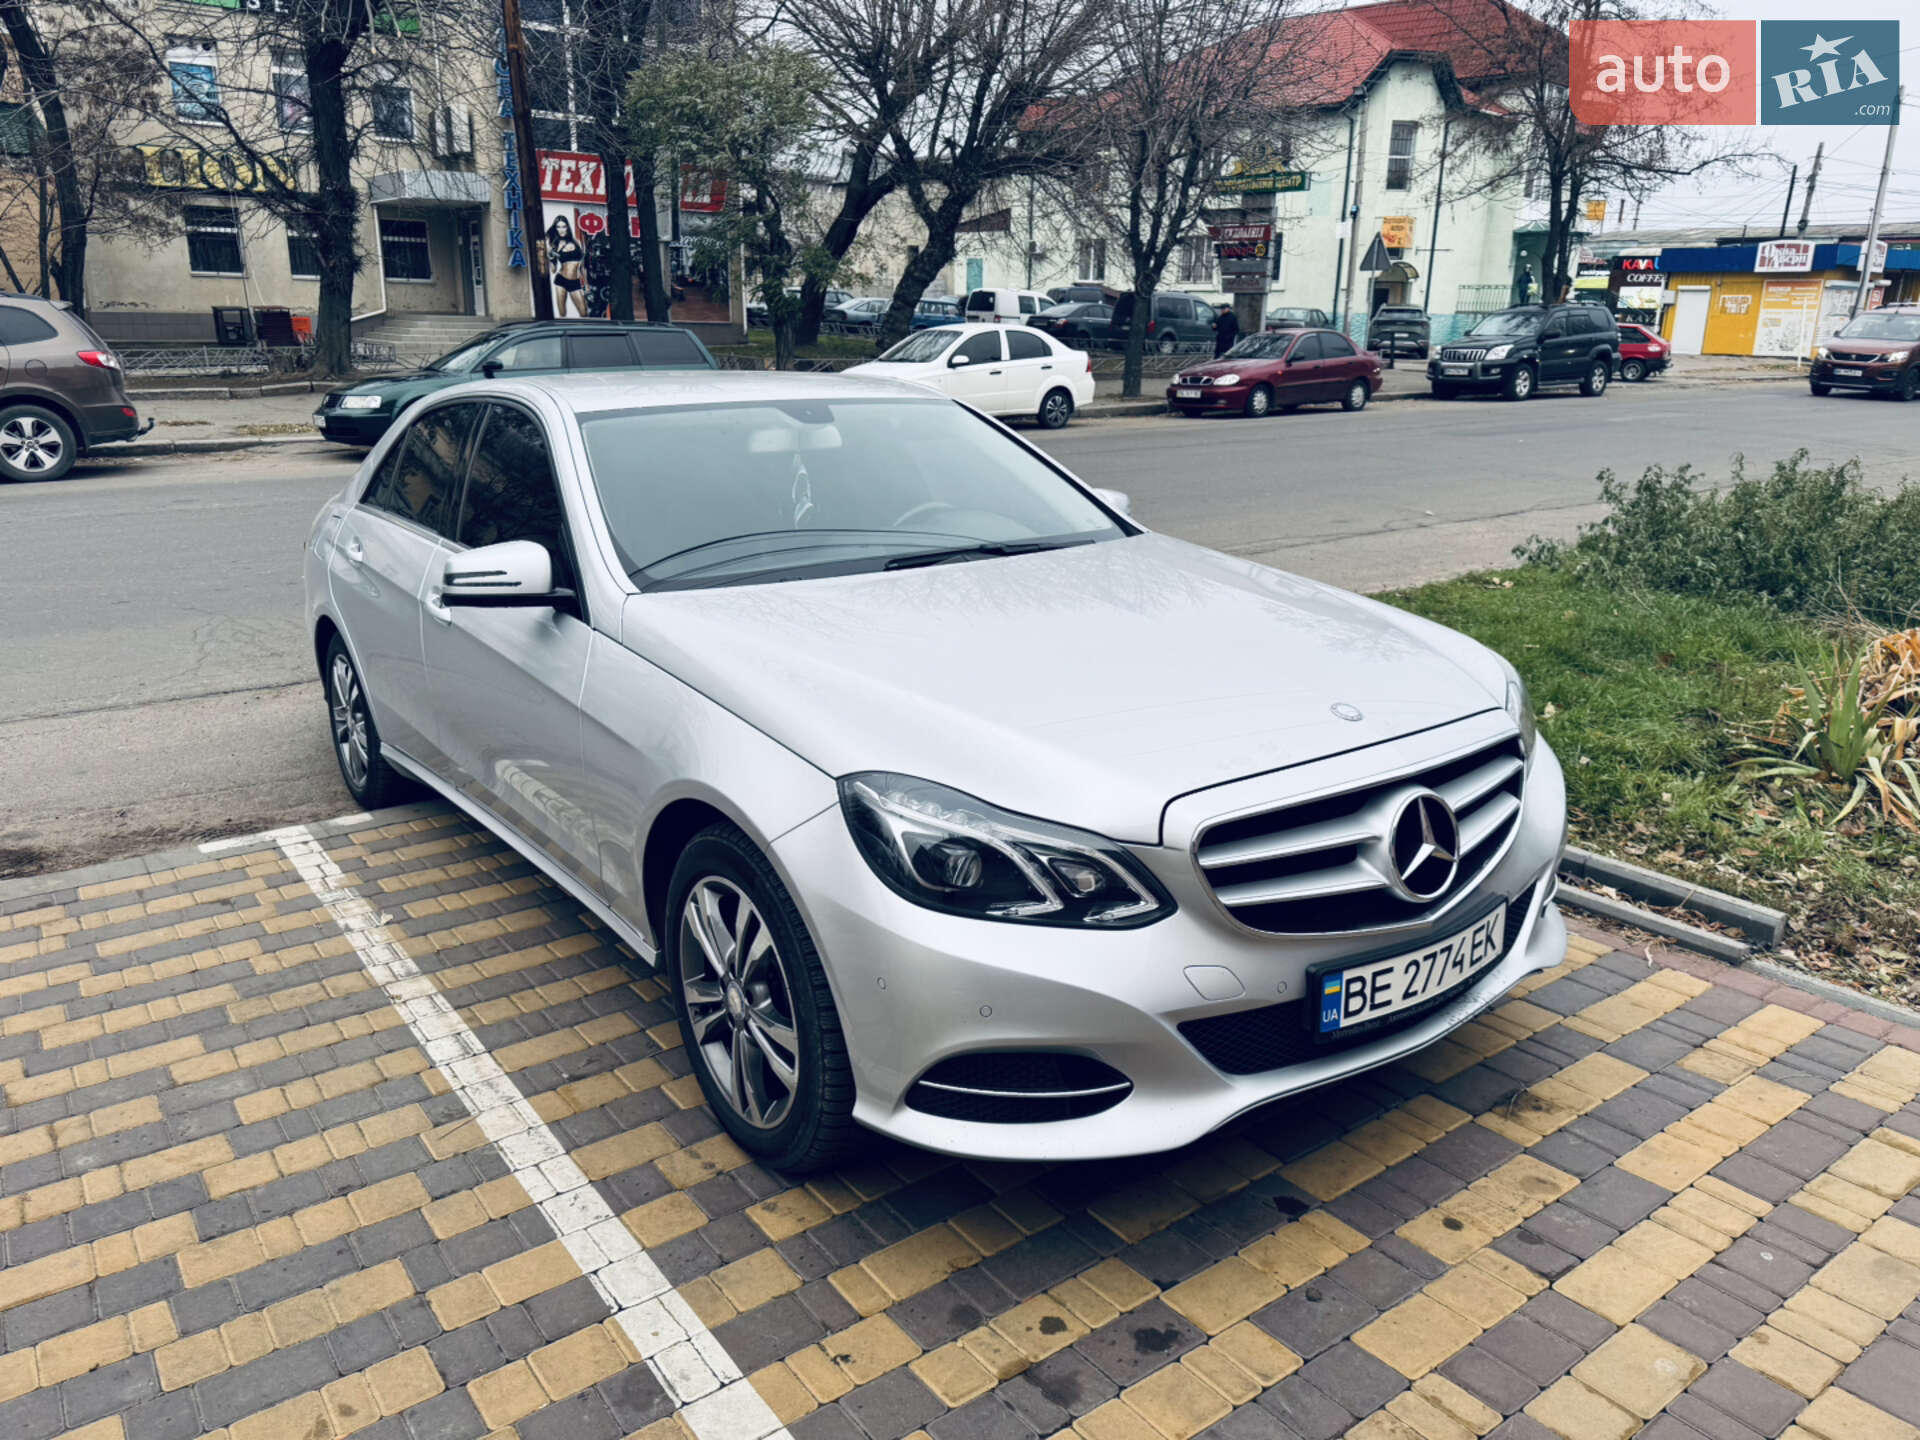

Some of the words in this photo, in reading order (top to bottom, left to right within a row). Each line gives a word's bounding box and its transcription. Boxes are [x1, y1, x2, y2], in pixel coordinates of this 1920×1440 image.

[502, 130, 527, 268] ТЕХНІКА
[1322, 1008, 1339, 1023] UA
[1343, 966, 1394, 1020] BE
[1402, 936, 1466, 1001] 2774
[1470, 913, 1499, 968] EK
